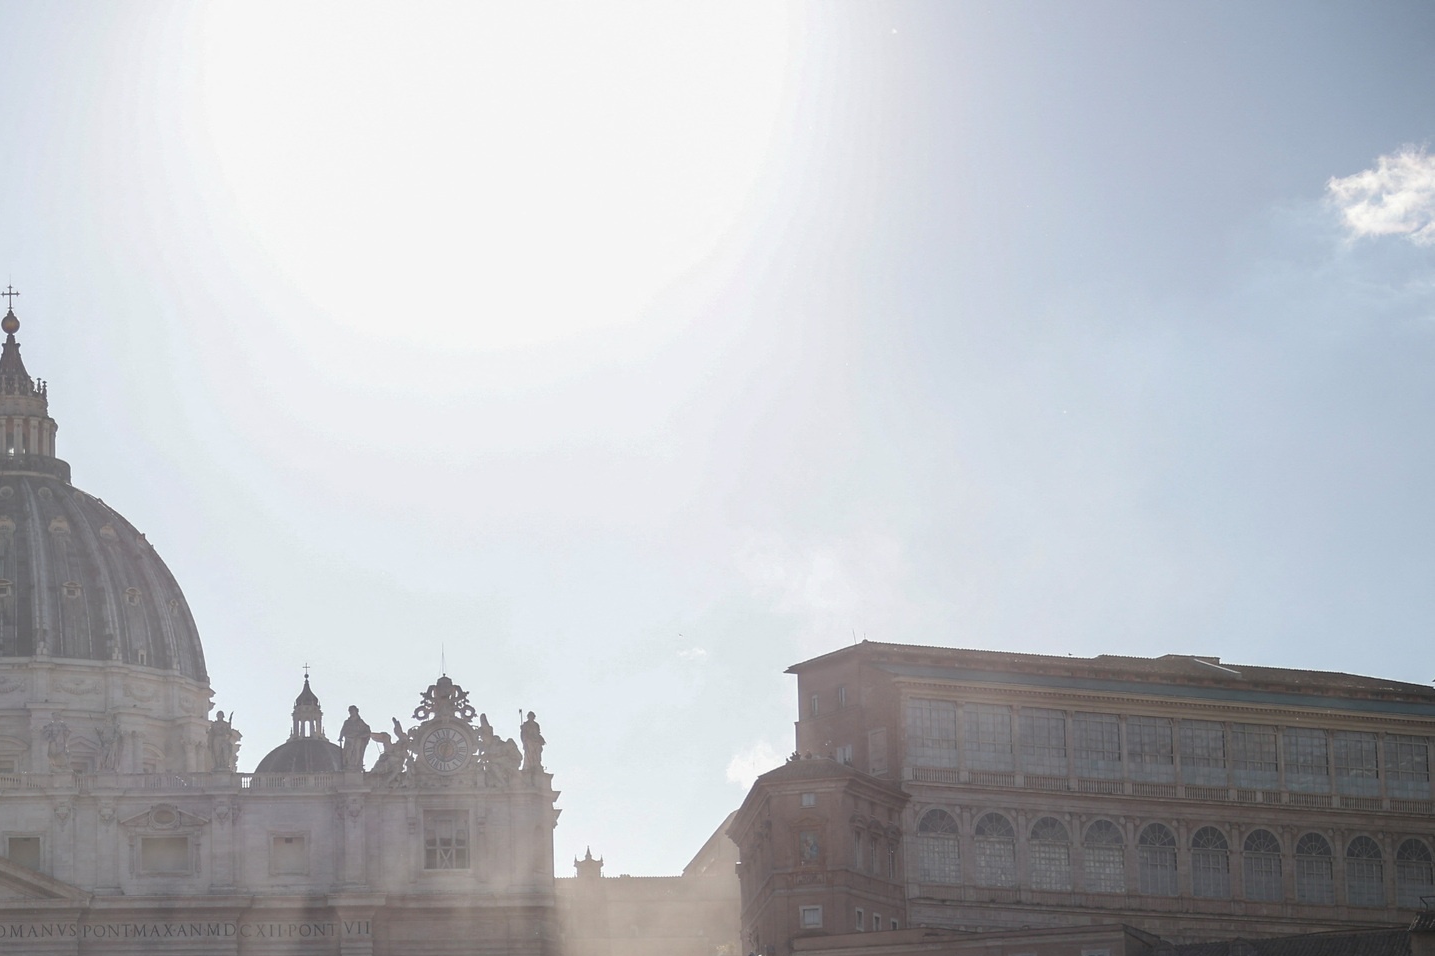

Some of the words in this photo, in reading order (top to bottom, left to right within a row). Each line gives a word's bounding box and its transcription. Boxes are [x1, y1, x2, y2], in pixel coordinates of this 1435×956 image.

[83, 923, 132, 938] PONT
[133, 923, 174, 938] MAX
[177, 923, 202, 937] AN
[207, 922, 282, 938] MDCXII
[288, 922, 338, 938] PONT
[343, 920, 370, 935] VII
